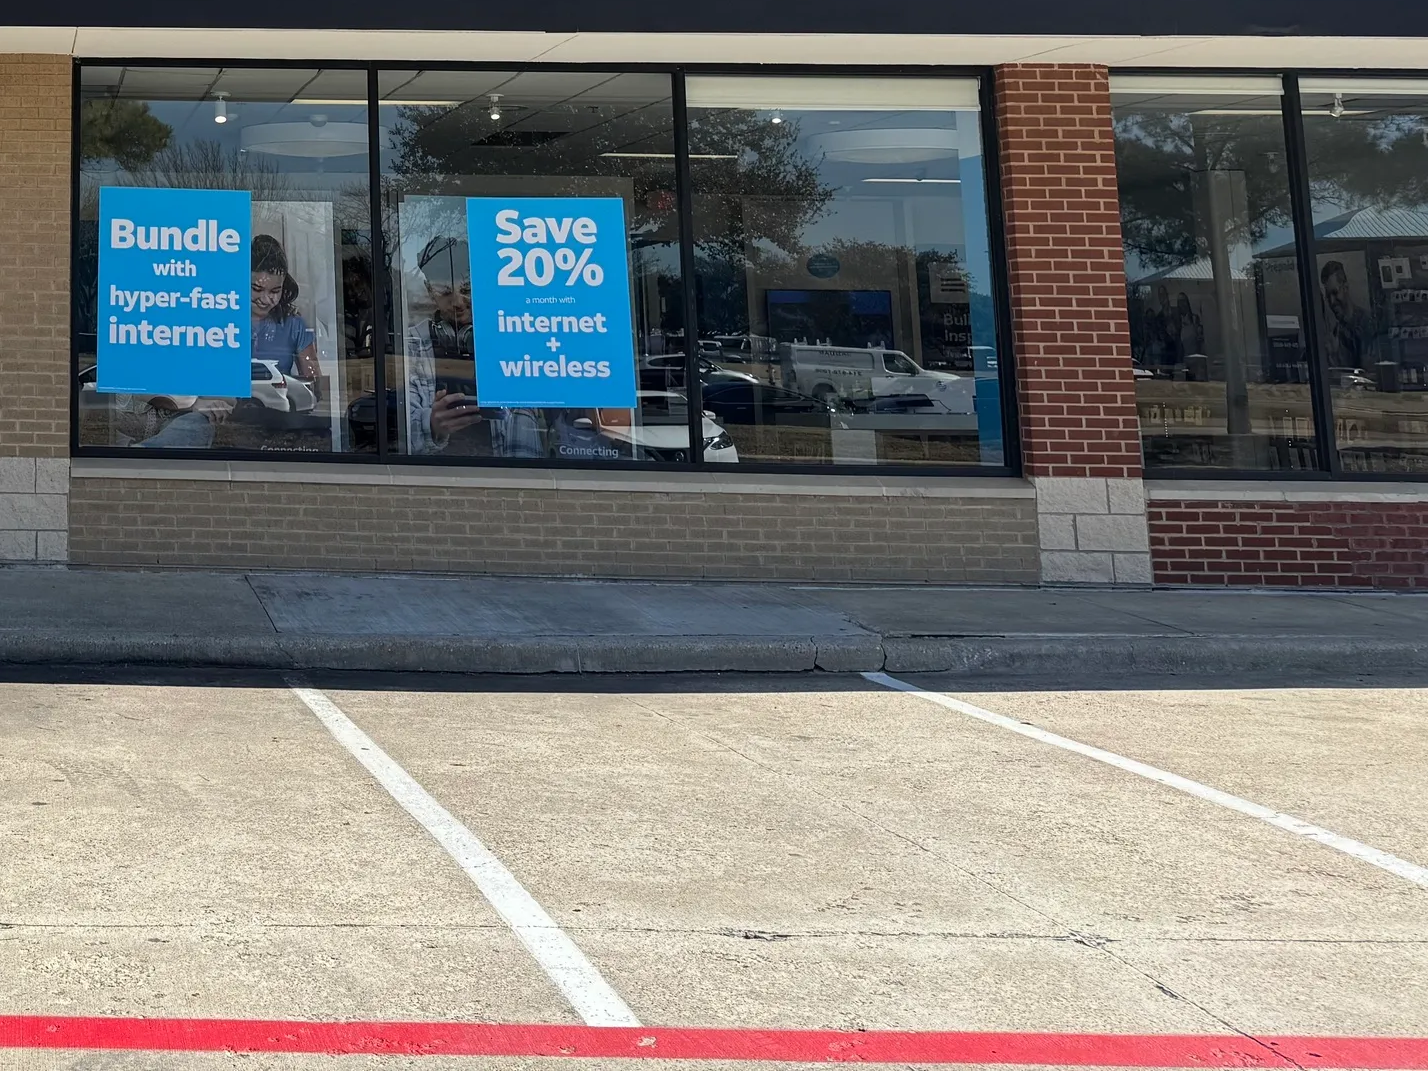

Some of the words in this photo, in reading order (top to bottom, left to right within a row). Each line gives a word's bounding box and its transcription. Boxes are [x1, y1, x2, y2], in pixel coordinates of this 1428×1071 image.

[110, 218, 241, 253] Bundle
[495, 209, 598, 244] Save
[152, 259, 197, 277] with
[496, 247, 604, 287] 20%
[110, 284, 240, 312] hyper-fast
[532, 296, 558, 304] month
[559, 296, 576, 304] with
[109, 316, 241, 348] internet
[497, 310, 608, 333] internet
[546, 337, 561, 352] +
[499, 354, 611, 377] wireless
[559, 445, 619, 459] Connecting
